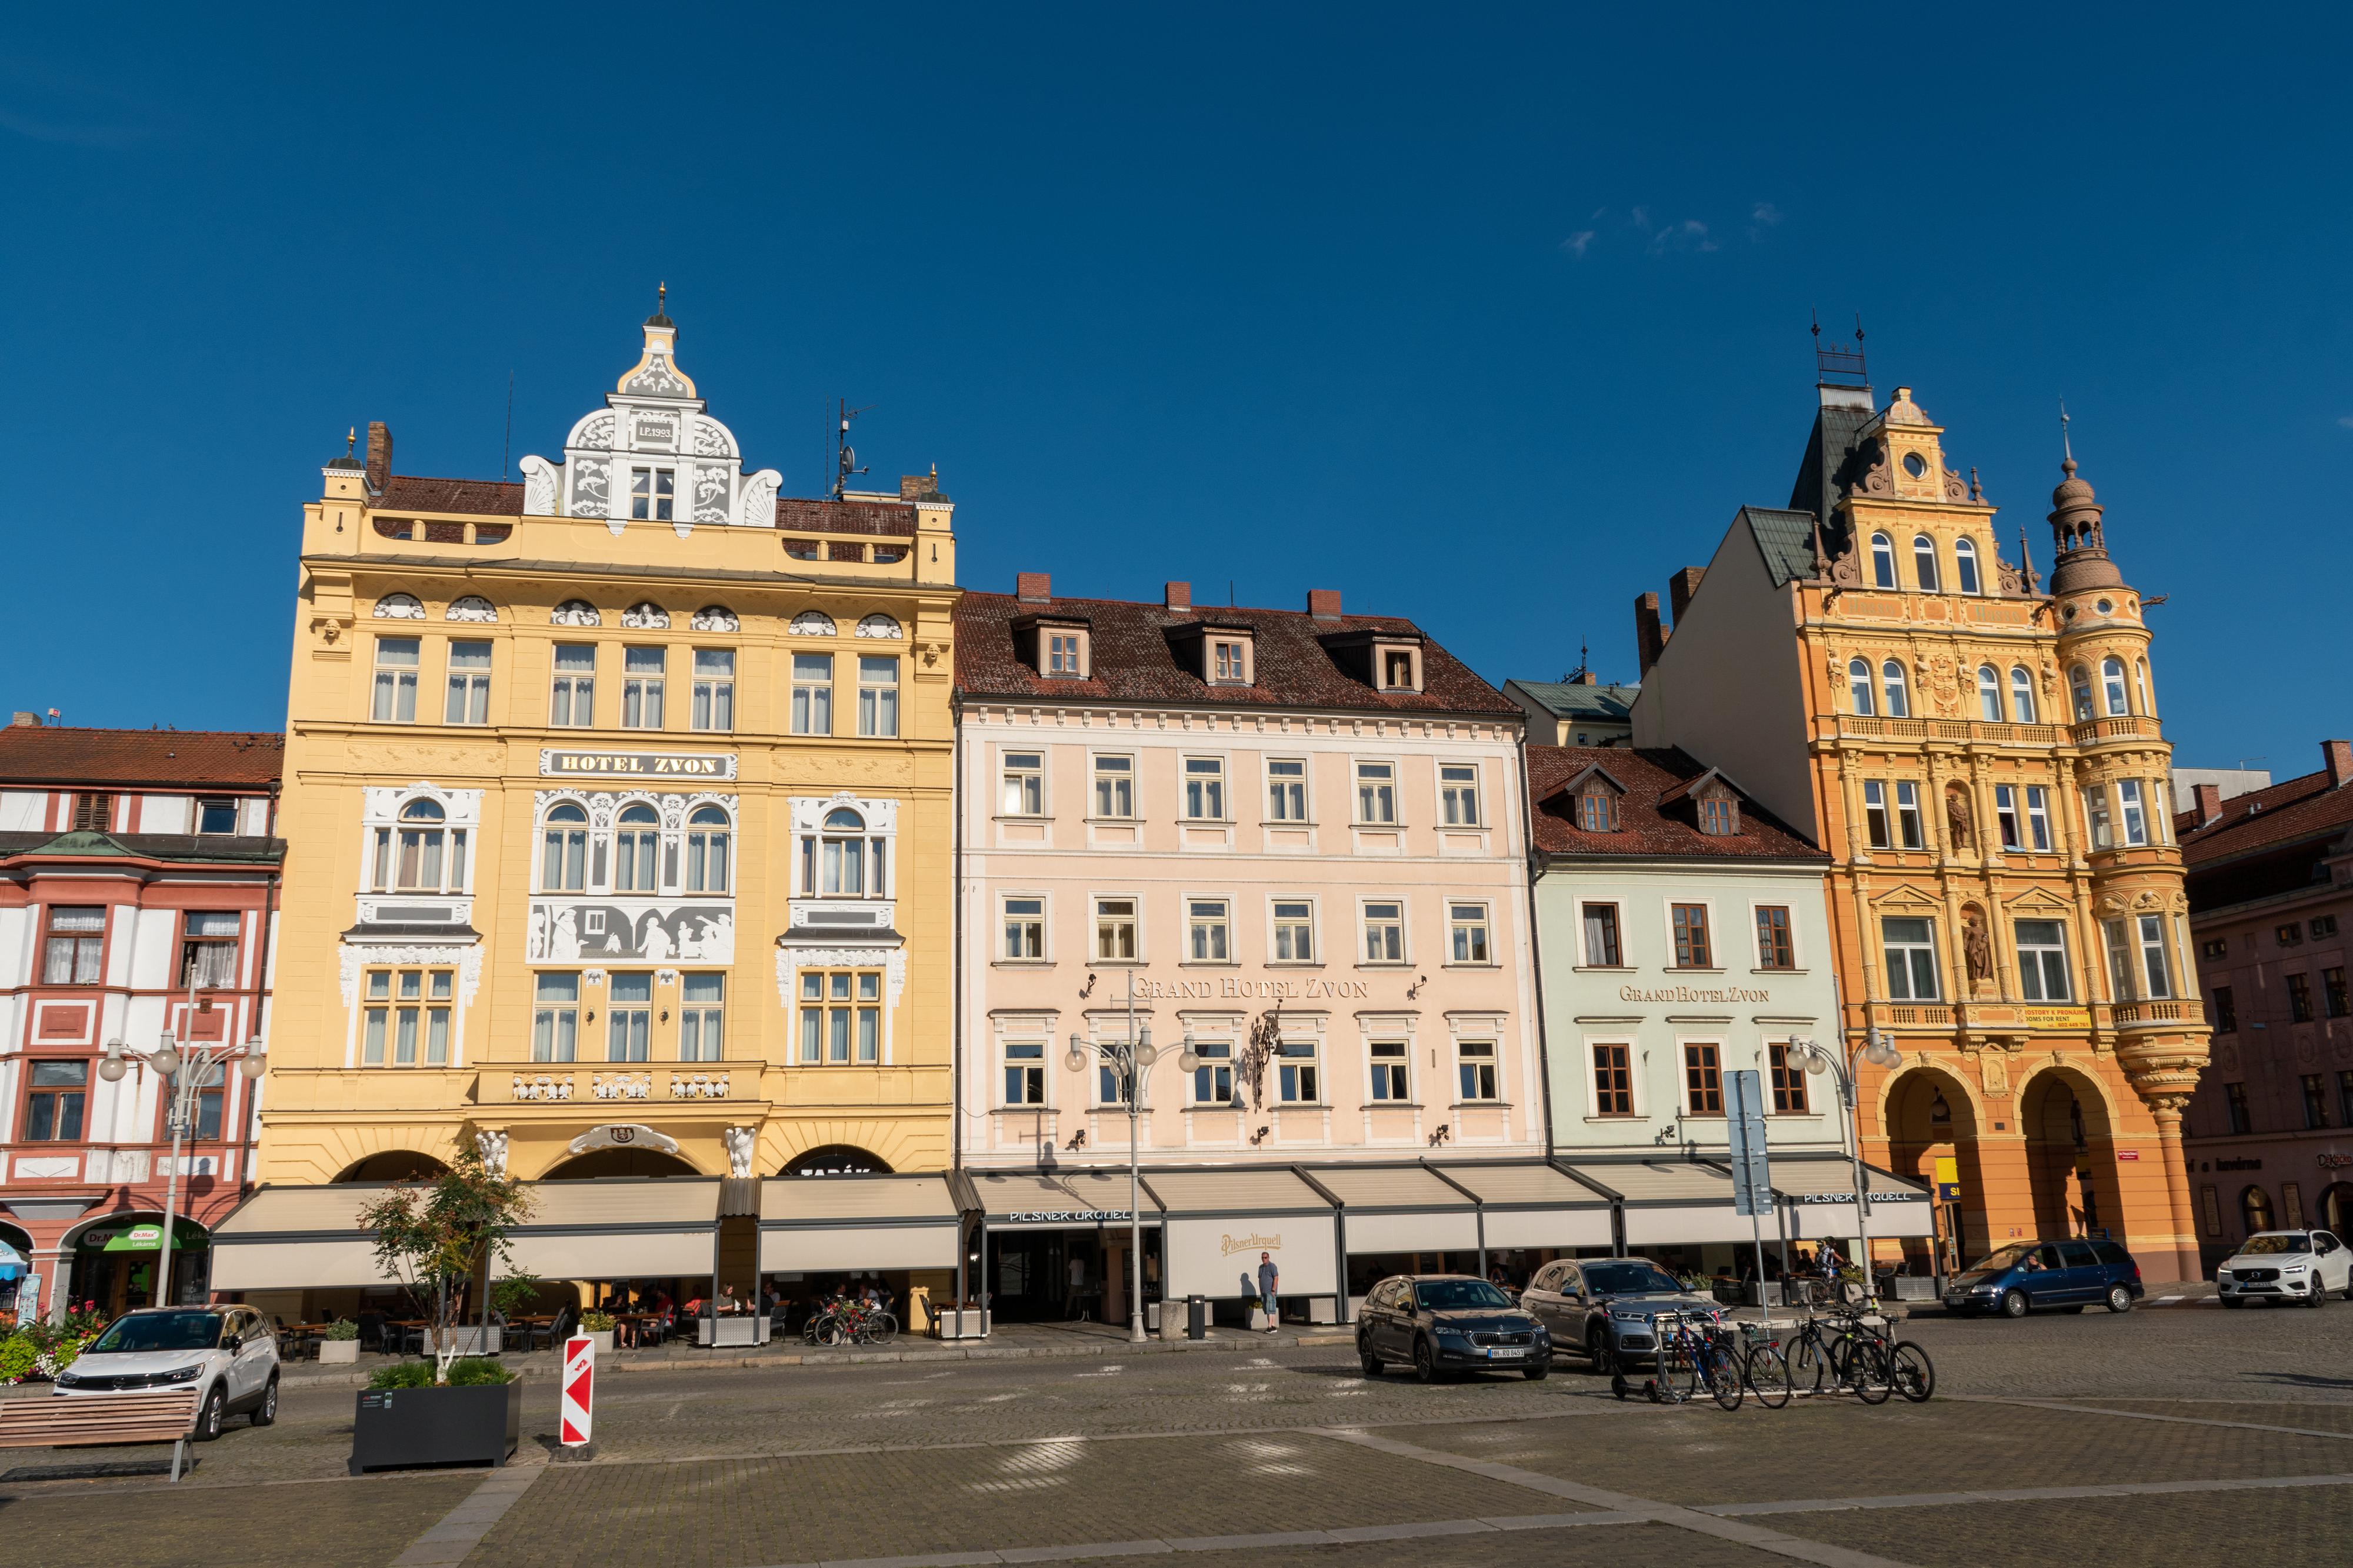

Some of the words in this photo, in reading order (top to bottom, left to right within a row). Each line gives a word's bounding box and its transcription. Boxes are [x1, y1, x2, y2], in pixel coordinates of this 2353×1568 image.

[562, 756, 644, 772] HOTEL
[655, 757, 717, 773] ZVON
[1132, 977, 1212, 998] GRAND
[1221, 978, 1299, 999] HOTEL
[1306, 978, 1369, 999] ZVON
[1619, 986, 1675, 1002] GRAND
[1675, 987, 1729, 1002] HOTEL
[1729, 987, 1770, 1003] ZVON
[1804, 1193, 1854, 1203] PILSNER
[1865, 1192, 1911, 1201] RQUELL
[1009, 1210, 1070, 1222] PILSNER
